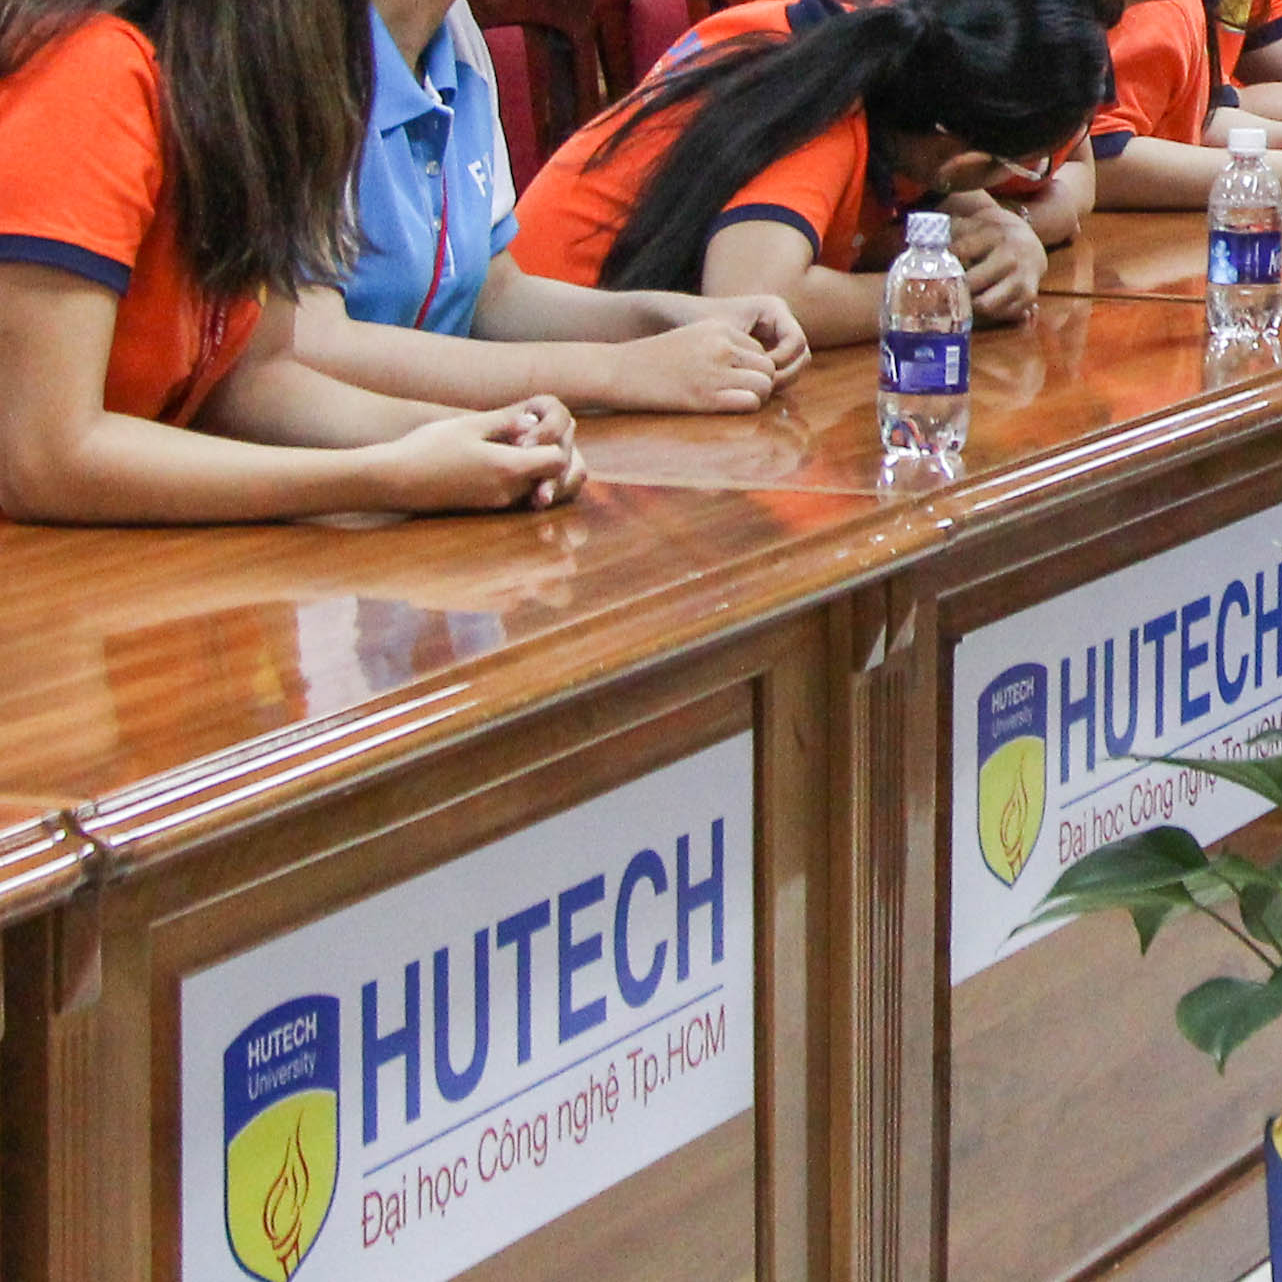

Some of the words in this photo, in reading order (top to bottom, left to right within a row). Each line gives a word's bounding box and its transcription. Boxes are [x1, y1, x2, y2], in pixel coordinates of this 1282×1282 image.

[1129, 778, 1174, 827] Công
[361, 817, 726, 1147] HUTECH
[247, 1011, 318, 1070] HUTECH
[247, 1049, 318, 1102] University
[361, 1173, 407, 1249] Đại
[418, 1165, 468, 1219] học
[478, 1113, 549, 1182] Công
[558, 1062, 620, 1145] nghệ
[626, 1002, 726, 1108] Tp.HCM
